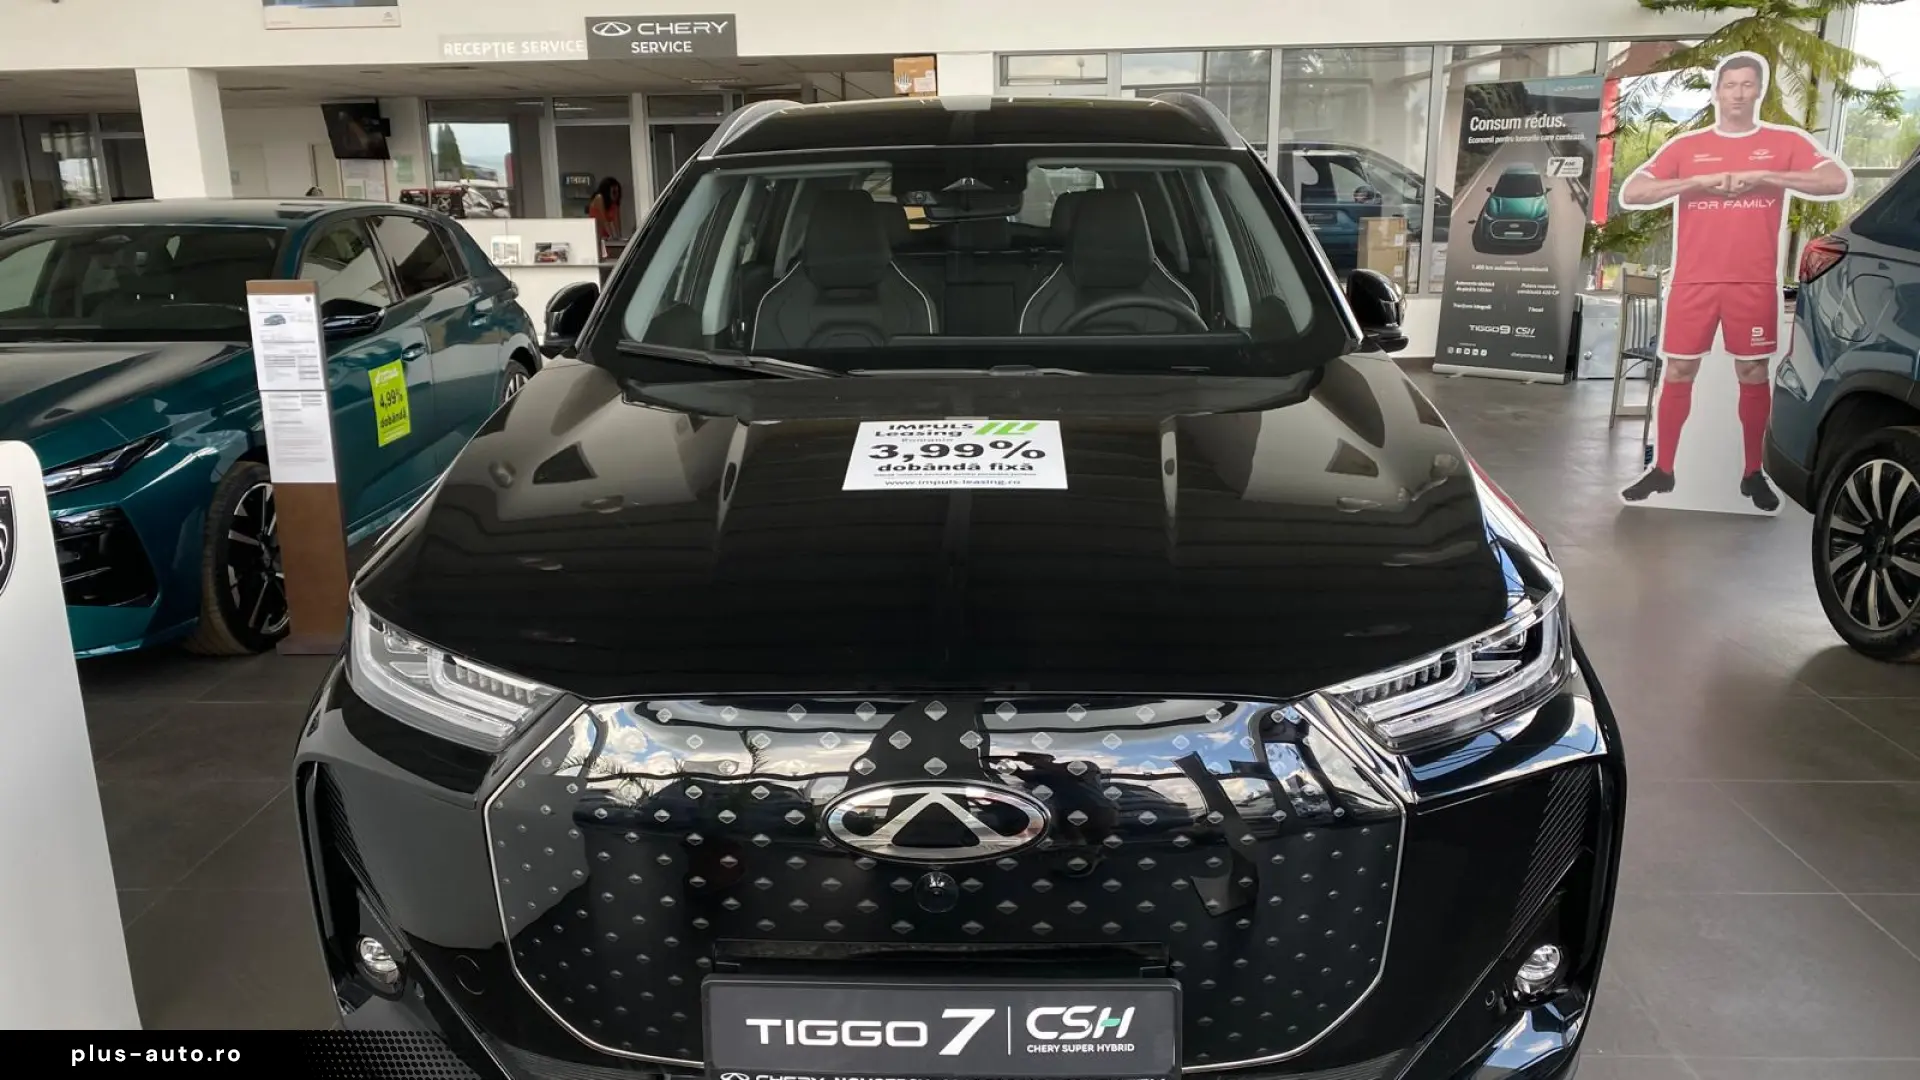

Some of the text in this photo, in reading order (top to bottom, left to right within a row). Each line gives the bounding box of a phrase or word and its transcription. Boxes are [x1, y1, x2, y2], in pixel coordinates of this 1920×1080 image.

[638, 21, 728, 35] CHERY
[521, 40, 585, 53] SERVICE
[631, 40, 692, 53] SERVICE
[1470, 114, 1566, 131] Consum redus.
[1688, 199, 1776, 210] FOR FAMILY
[1752, 327, 1763, 337] 9
[868, 440, 1046, 462] 3,99%
[745, 1005, 1135, 1056] TIGGO 7 CSH
[1026, 1043, 1135, 1053] CHERY SUPER HYBRID
